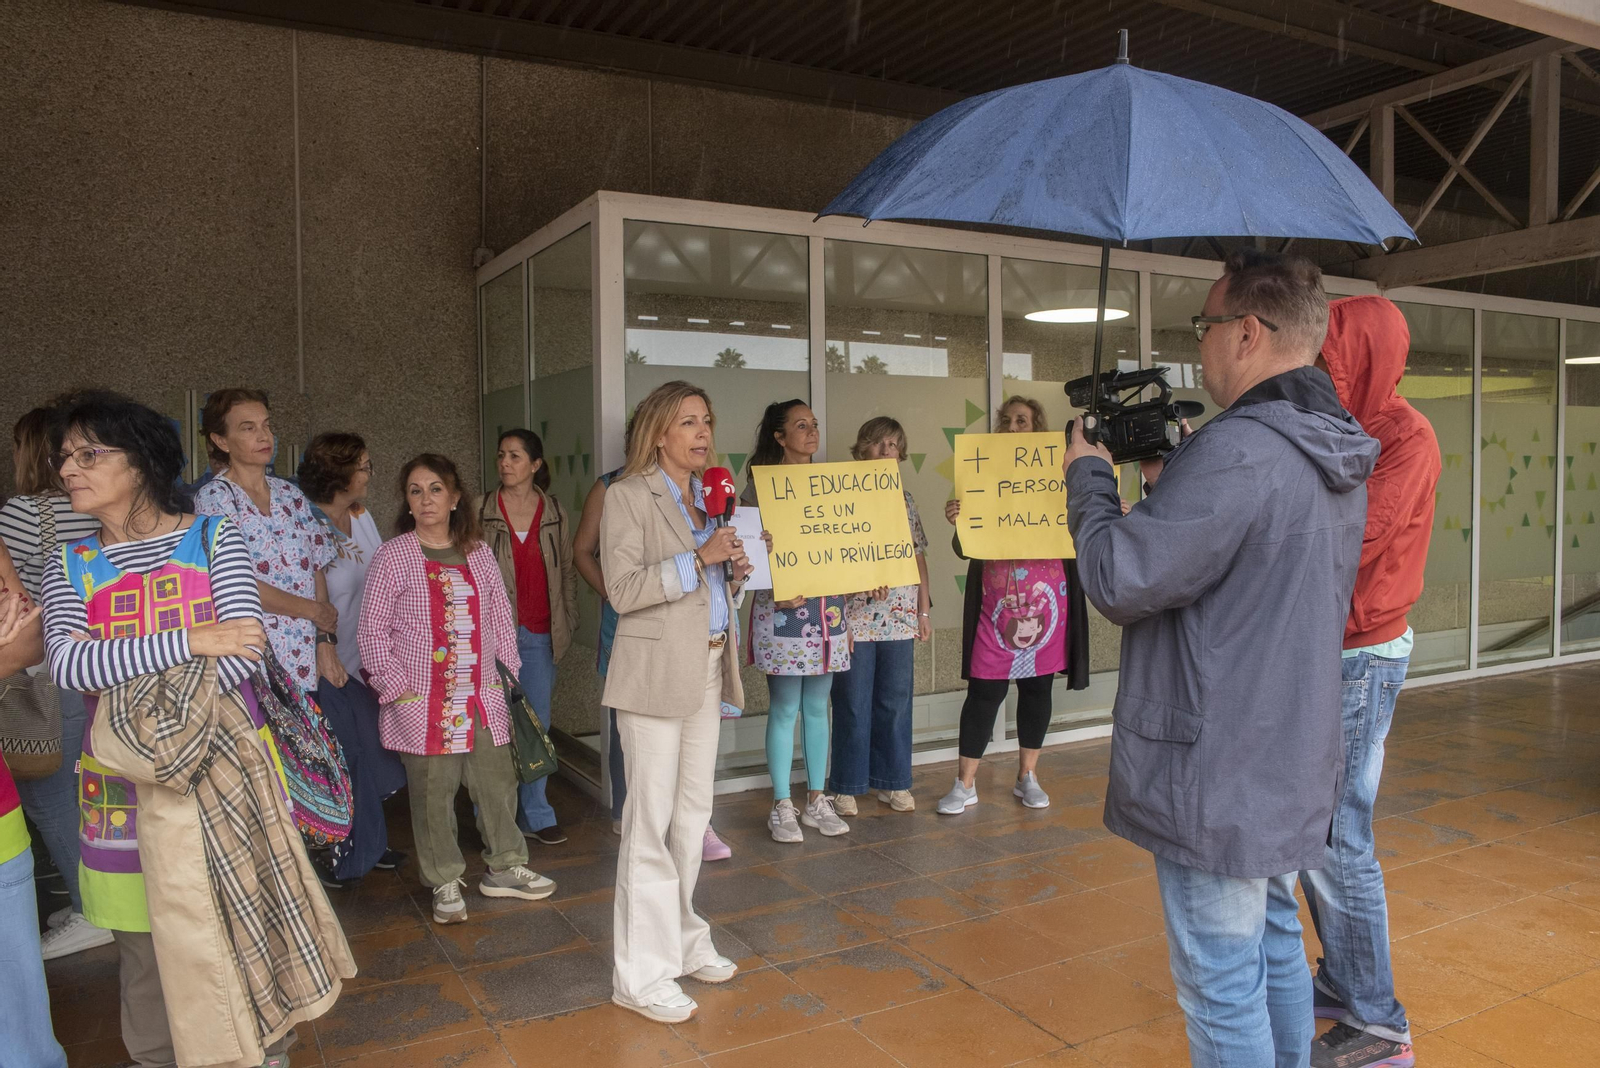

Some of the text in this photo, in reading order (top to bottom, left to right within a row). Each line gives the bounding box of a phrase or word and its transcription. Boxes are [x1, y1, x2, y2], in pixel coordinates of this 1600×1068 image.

[1015, 445, 1058, 468] RAT
[771, 468, 900, 501] LA EDUCACIÓN
[997, 478, 1067, 498] PERSON
[803, 502, 855, 519] ES UN
[998, 511, 1051, 528] MALA
[1056, 513, 1068, 526] C
[799, 521, 872, 535] DERECHO
[775, 539, 914, 569] NO UN PRIVILEGIO
[1334, 1040, 1391, 1067] STORM
